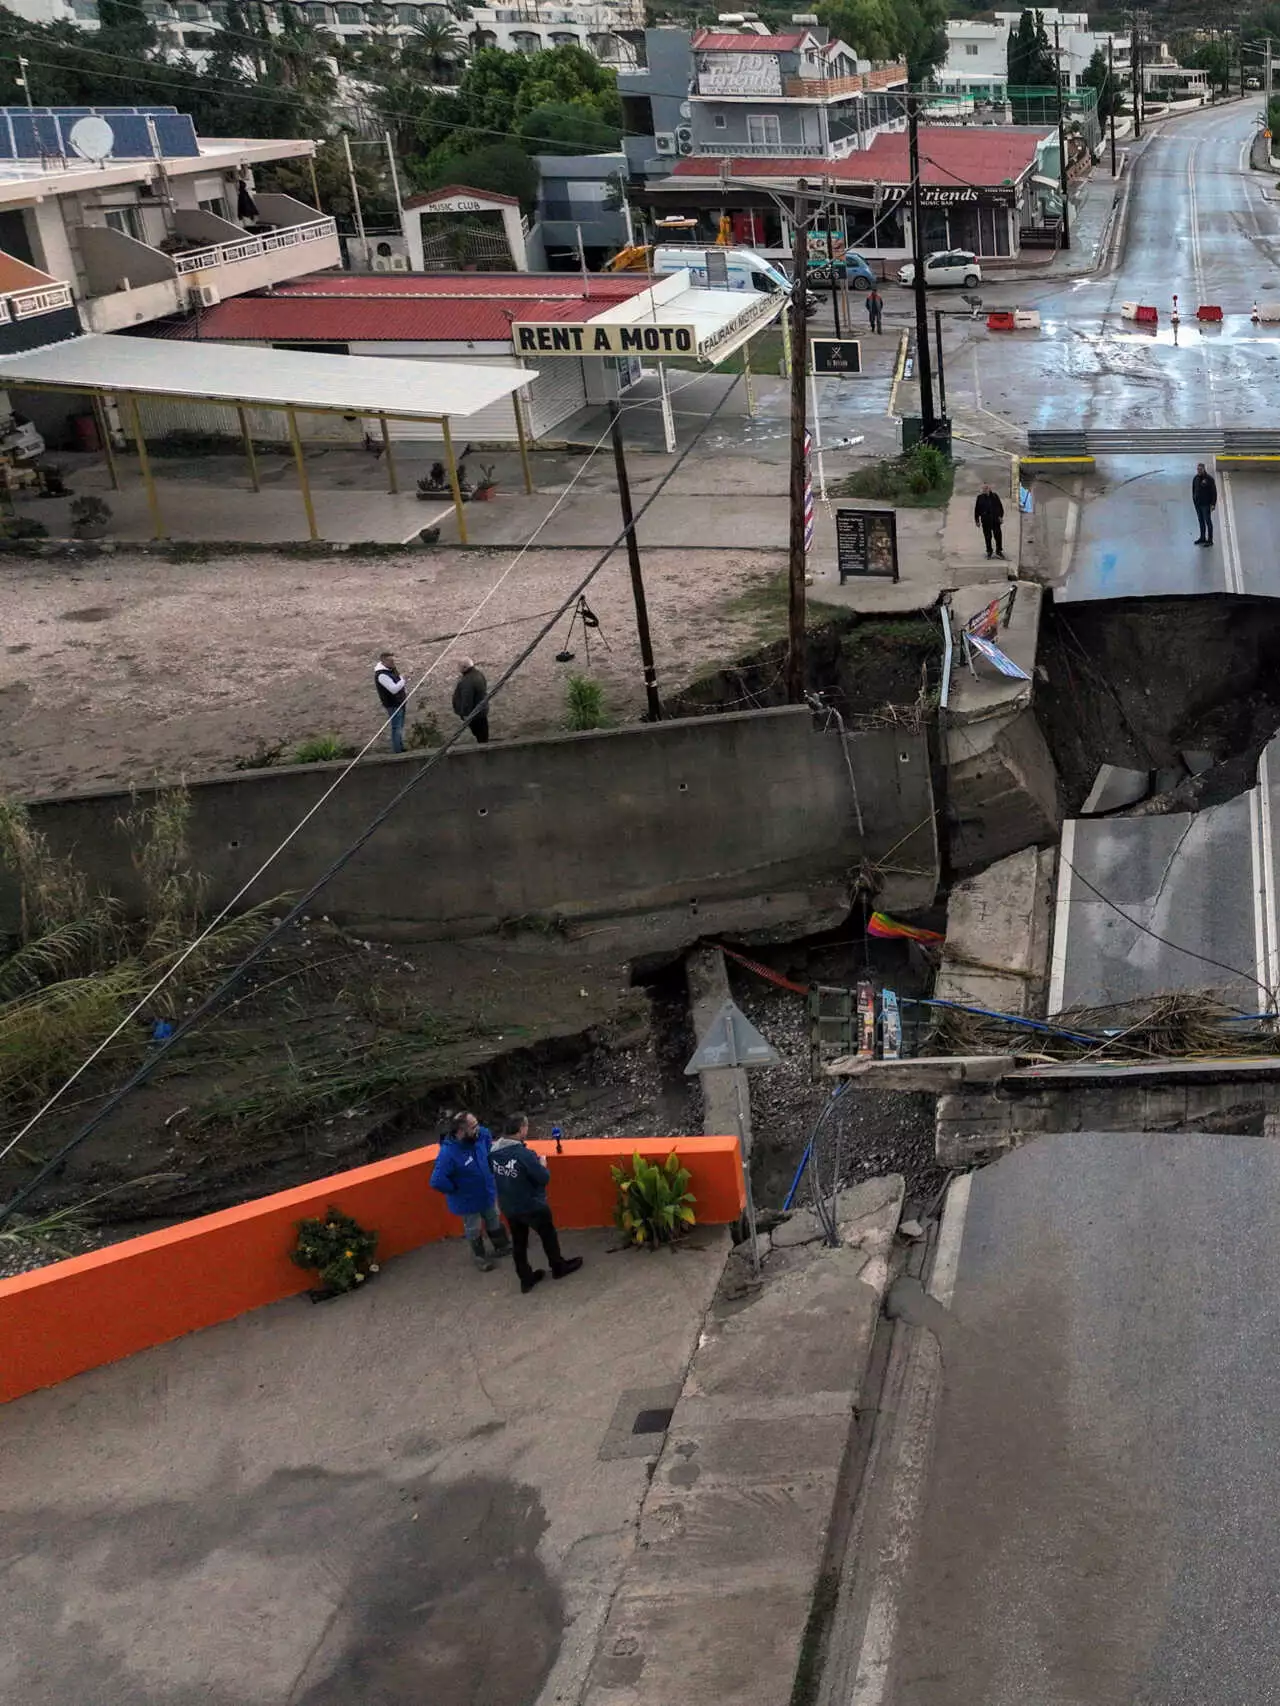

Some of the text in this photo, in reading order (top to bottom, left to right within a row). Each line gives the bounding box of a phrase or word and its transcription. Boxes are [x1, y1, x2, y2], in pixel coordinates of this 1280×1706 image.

[428, 202, 481, 211] MUSIC CLUB
[518, 327, 691, 351] RENT A MOTO
[703, 320, 738, 350] FALIRAKI
[738, 306, 759, 328] MOTO
